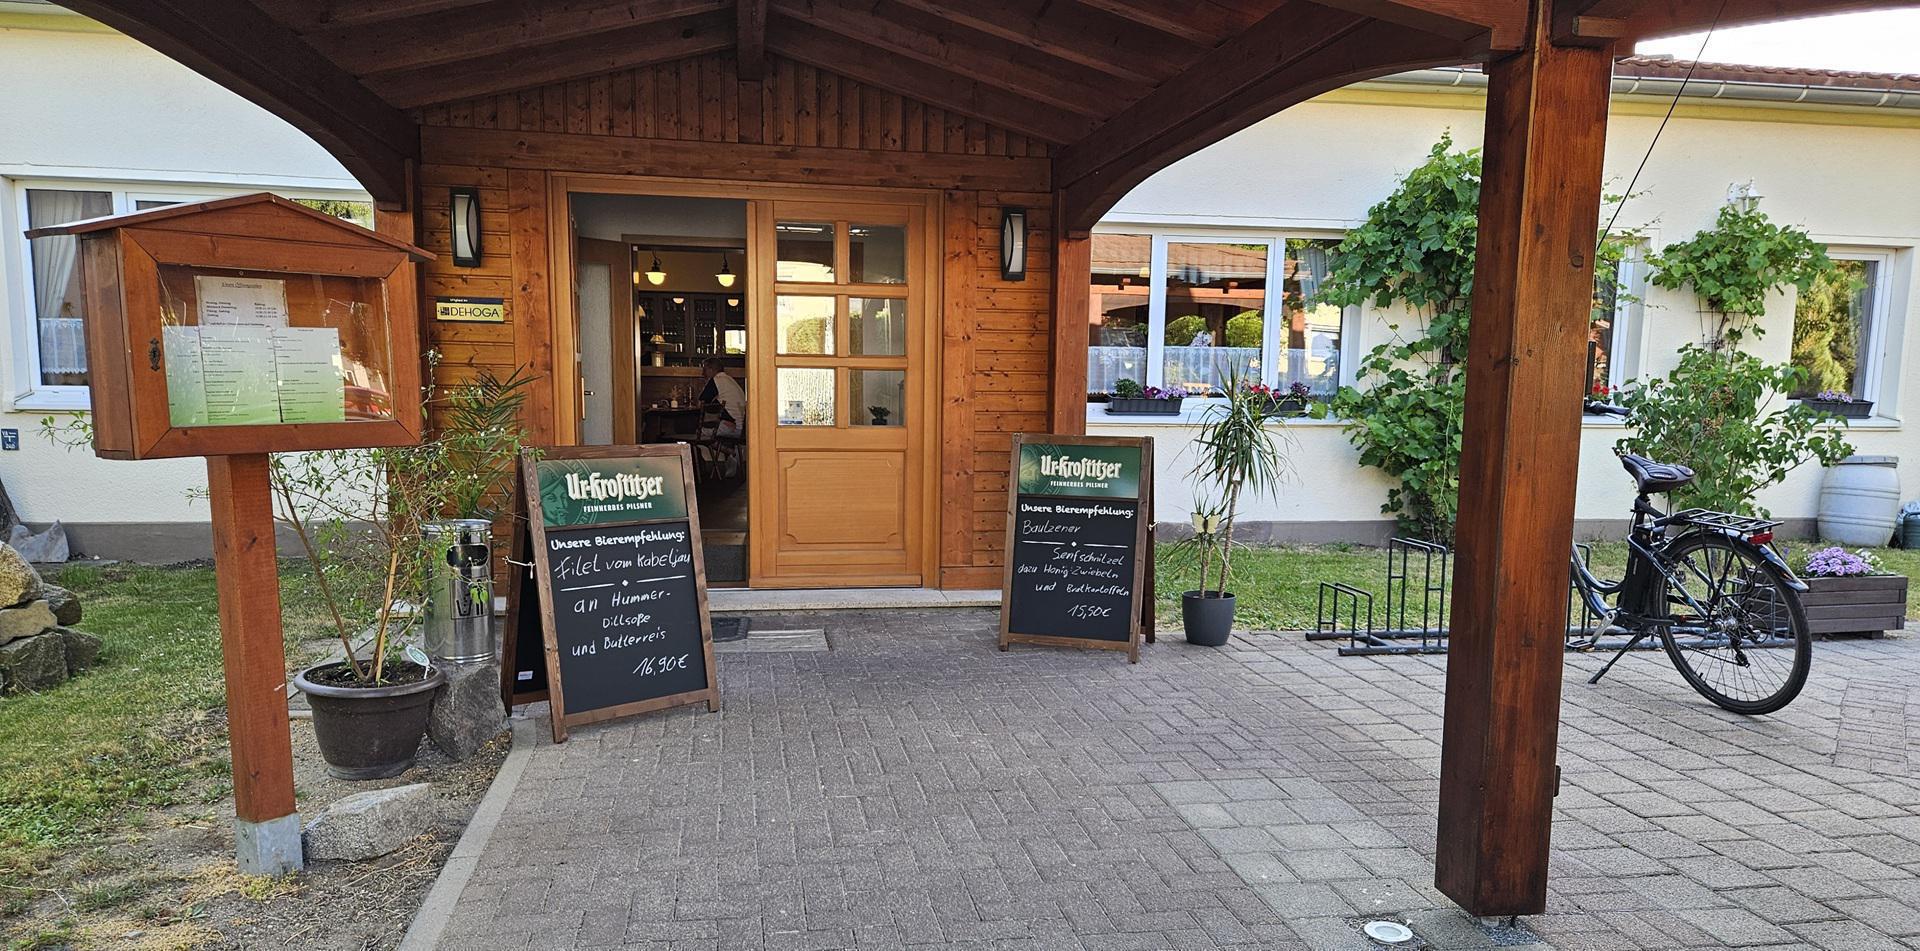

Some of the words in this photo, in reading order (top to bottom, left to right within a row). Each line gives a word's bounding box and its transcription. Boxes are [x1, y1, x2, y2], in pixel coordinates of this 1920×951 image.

[450, 307, 500, 317] DEHOGA
[1050, 480, 1084, 488] FEINHERBES
[583, 504, 624, 513] FEINHERBES
[626, 502, 653, 511] PILSNER
[1021, 503, 1053, 513] Unsere
[1055, 505, 1135, 519] Bierempfehlung:
[1022, 520, 1081, 535] Bautzener
[551, 537, 592, 551] Unsere
[594, 530, 685, 549] Bierempfehlung:
[553, 553, 601, 580] Filet
[605, 560, 633, 570] vom
[637, 547, 691, 568] Kabeljau
[1018, 563, 1039, 575] dazu
[1035, 582, 1057, 593] und
[1066, 583, 1129, 600] Bratkartoffeln
[574, 599, 598, 613] an
[611, 590, 671, 608] Hummer-
[1067, 604, 1112, 620] 15,50€
[602, 612, 651, 629] Dillsoße
[572, 641, 596, 657] und
[604, 627, 667, 650] Butterreis
[632, 654, 689, 677] 16,90€
